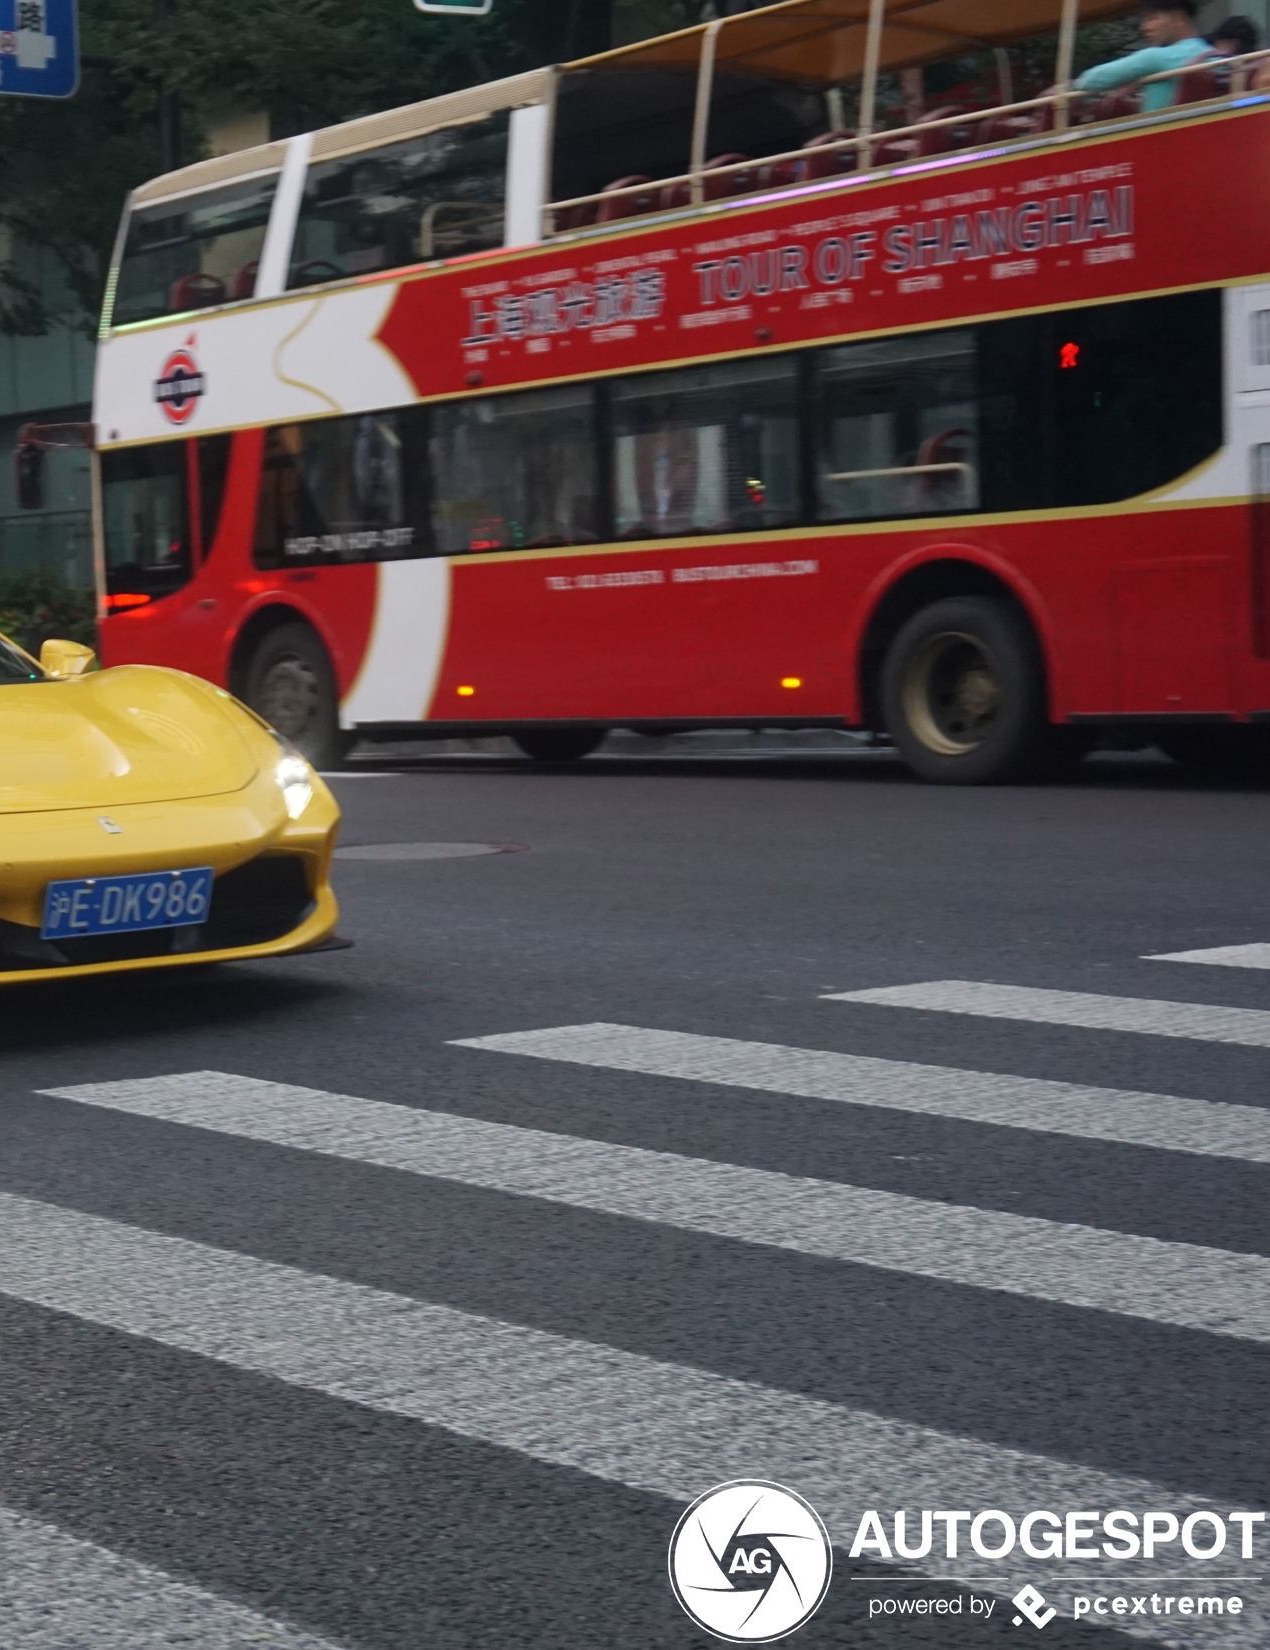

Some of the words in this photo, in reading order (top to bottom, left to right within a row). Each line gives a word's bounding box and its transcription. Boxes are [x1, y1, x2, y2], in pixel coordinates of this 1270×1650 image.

[691, 245, 810, 305] TOUR
[813, 230, 878, 285] OF
[881, 184, 1134, 274] SHANGHAI
